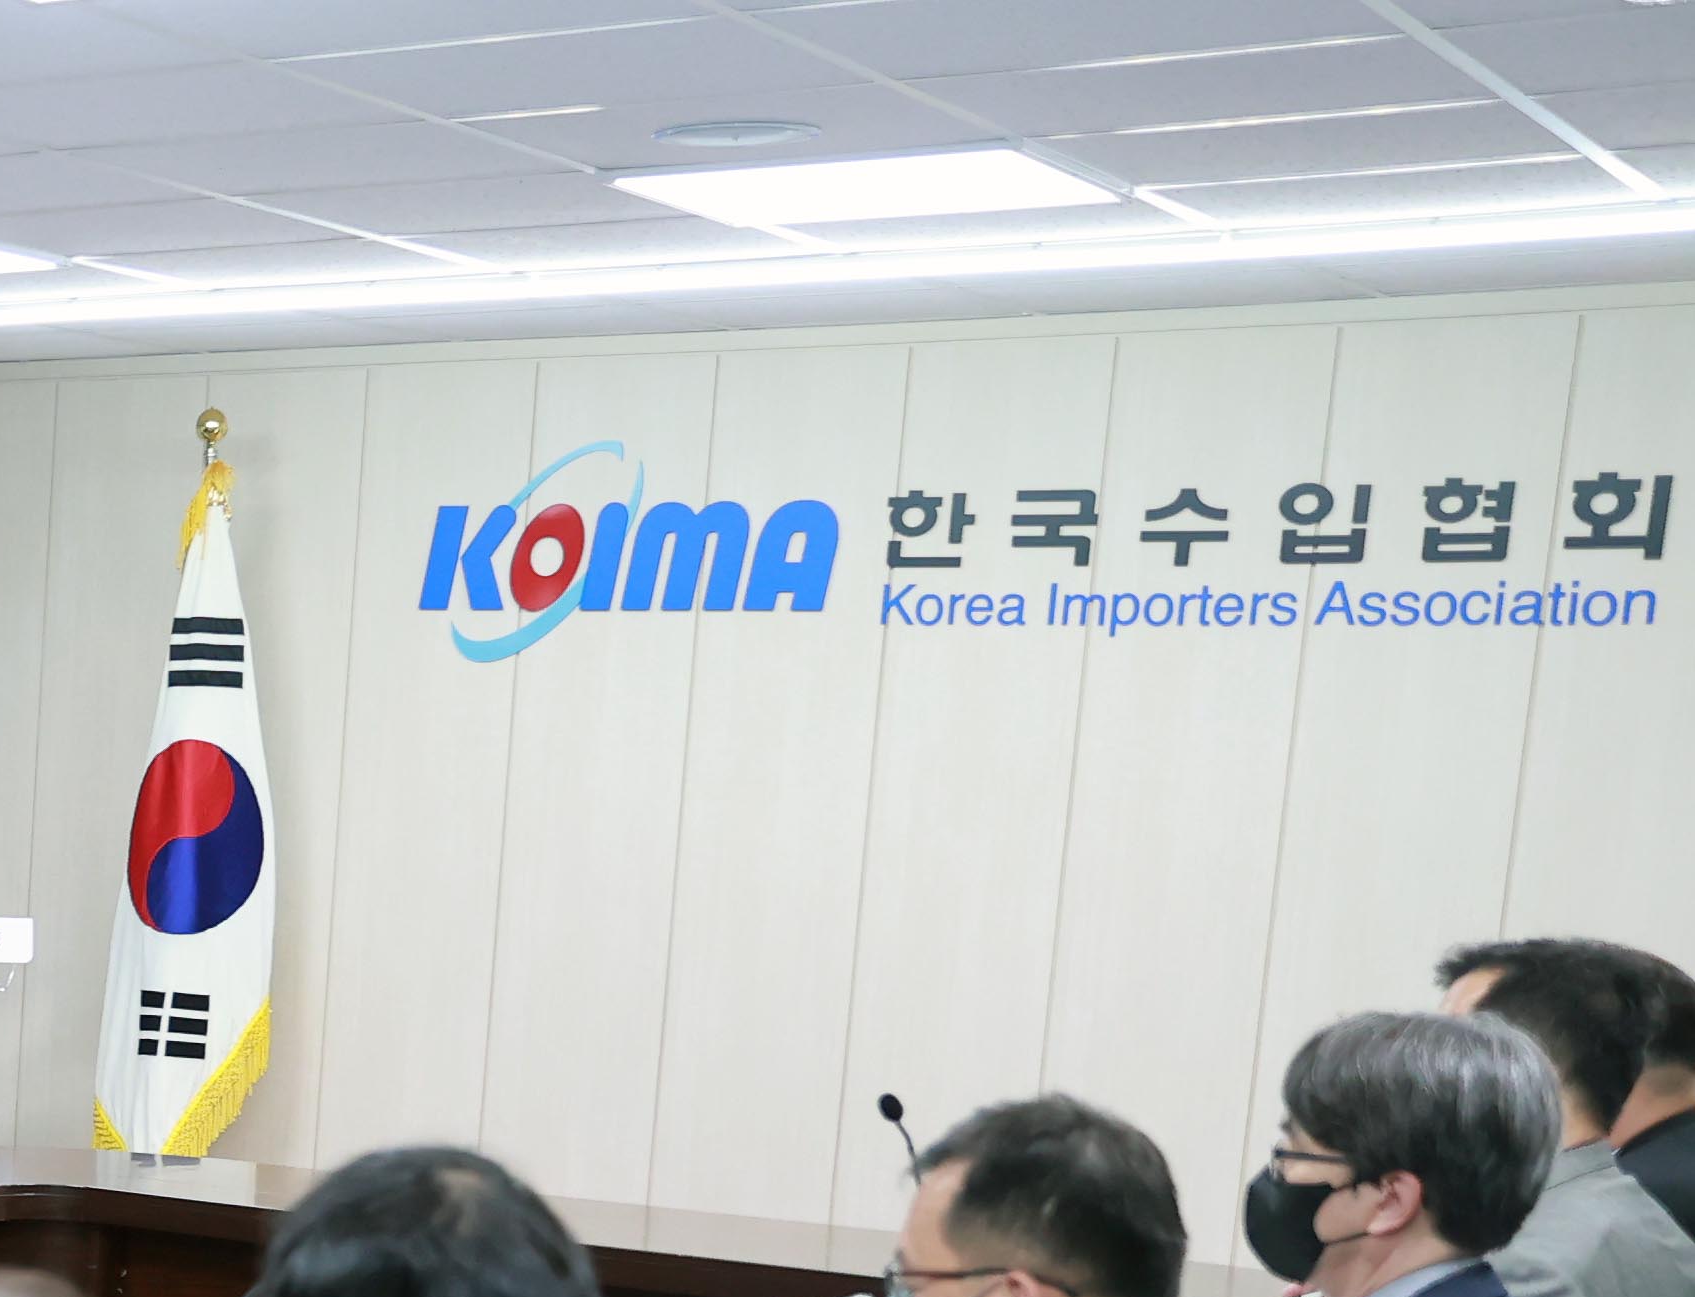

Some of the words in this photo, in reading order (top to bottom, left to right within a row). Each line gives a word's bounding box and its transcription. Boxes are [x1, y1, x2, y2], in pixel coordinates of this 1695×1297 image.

[419, 500, 839, 612] KOIMA
[886, 472, 1673, 569] 한국수입협회
[881, 582, 1027, 628] Korea
[1047, 582, 1299, 638] Importers
[1315, 580, 1658, 628] Association
